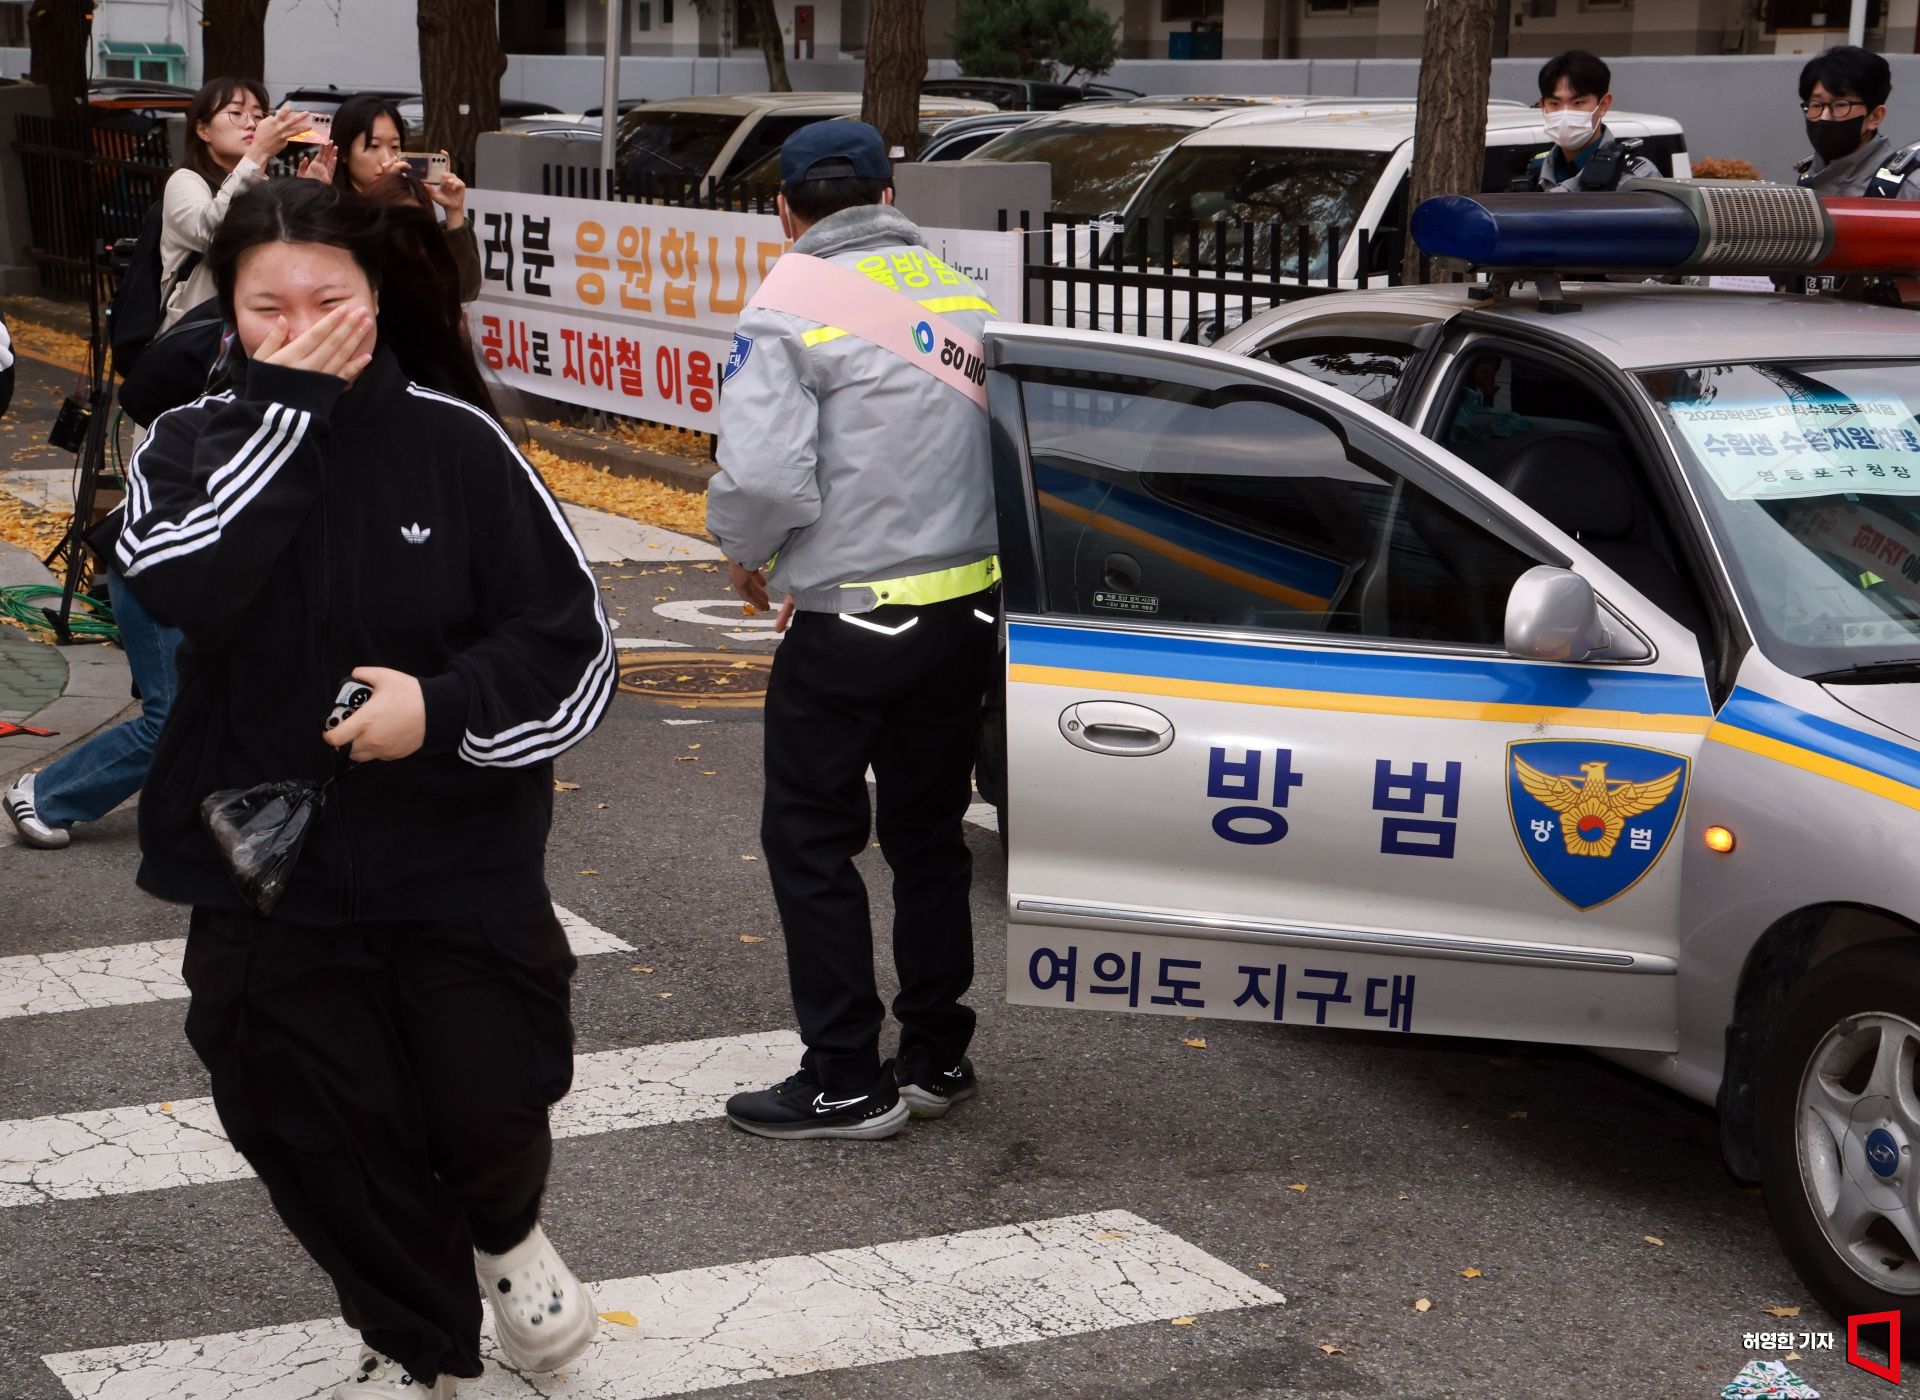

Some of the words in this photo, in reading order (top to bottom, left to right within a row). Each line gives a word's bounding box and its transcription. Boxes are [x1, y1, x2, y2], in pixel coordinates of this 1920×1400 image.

[466, 208, 555, 298] 러분
[482, 315, 553, 377] 공사로
[560, 328, 644, 397] 지하철
[656, 345, 724, 413] 이용
[1686, 407, 1775, 422] 2025학년도
[1776, 403, 1897, 417] 대학수학능력시험
[1704, 432, 1779, 458] 수험생
[1531, 819, 1555, 843] 방
[1630, 827, 1652, 850] 범
[1028, 945, 1206, 1009] 여의도
[1232, 963, 1416, 1033] 지구대
